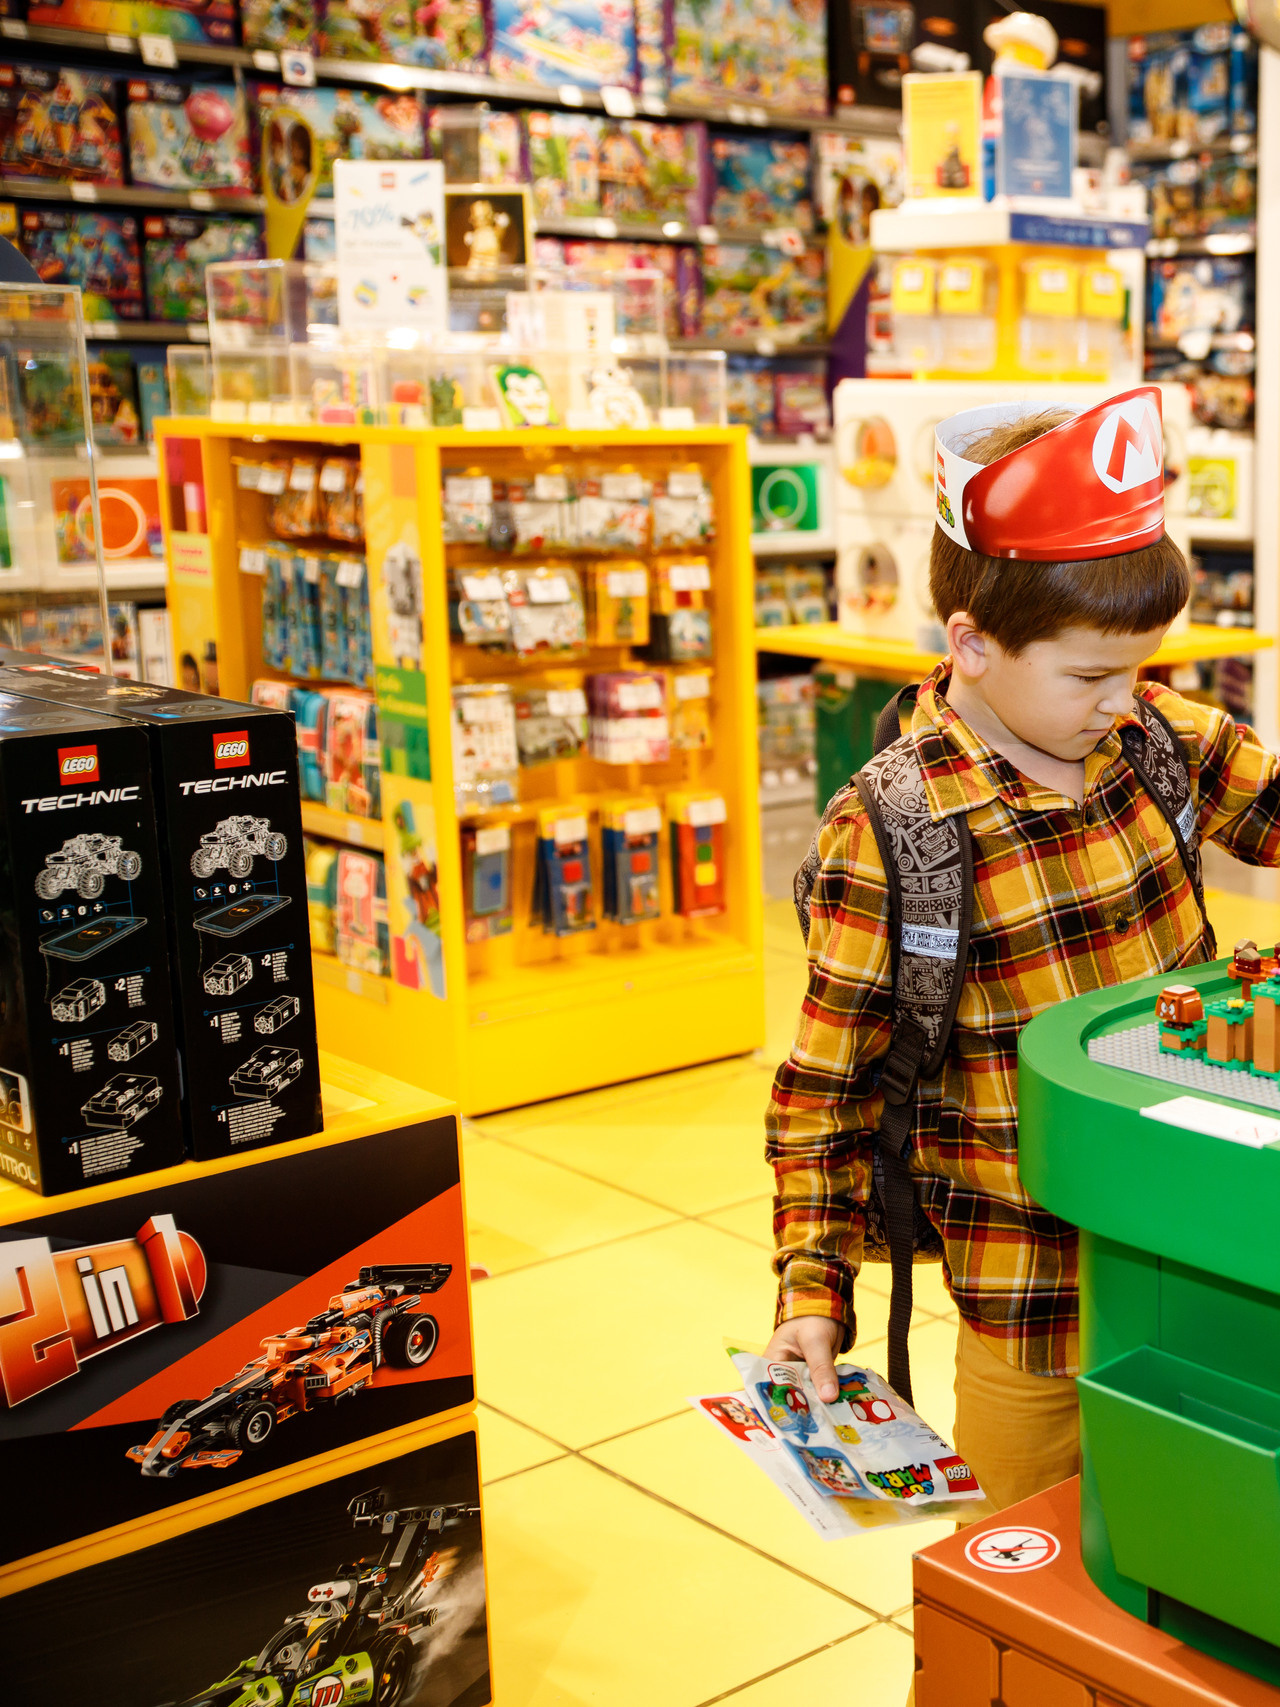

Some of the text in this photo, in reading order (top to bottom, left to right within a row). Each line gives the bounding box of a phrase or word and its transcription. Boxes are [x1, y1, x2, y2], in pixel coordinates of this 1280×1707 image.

[215, 740, 249, 759] LEGO
[61, 755, 97, 775] LEGO
[179, 770, 287, 796] TECHNIC
[21, 786, 141, 814] TECHNIC
[0, 1152, 38, 1185] TROL
[76, 1255, 139, 1339] in
[865, 1463, 933, 1488] MARIO
[945, 1464, 971, 1480] LEGO
